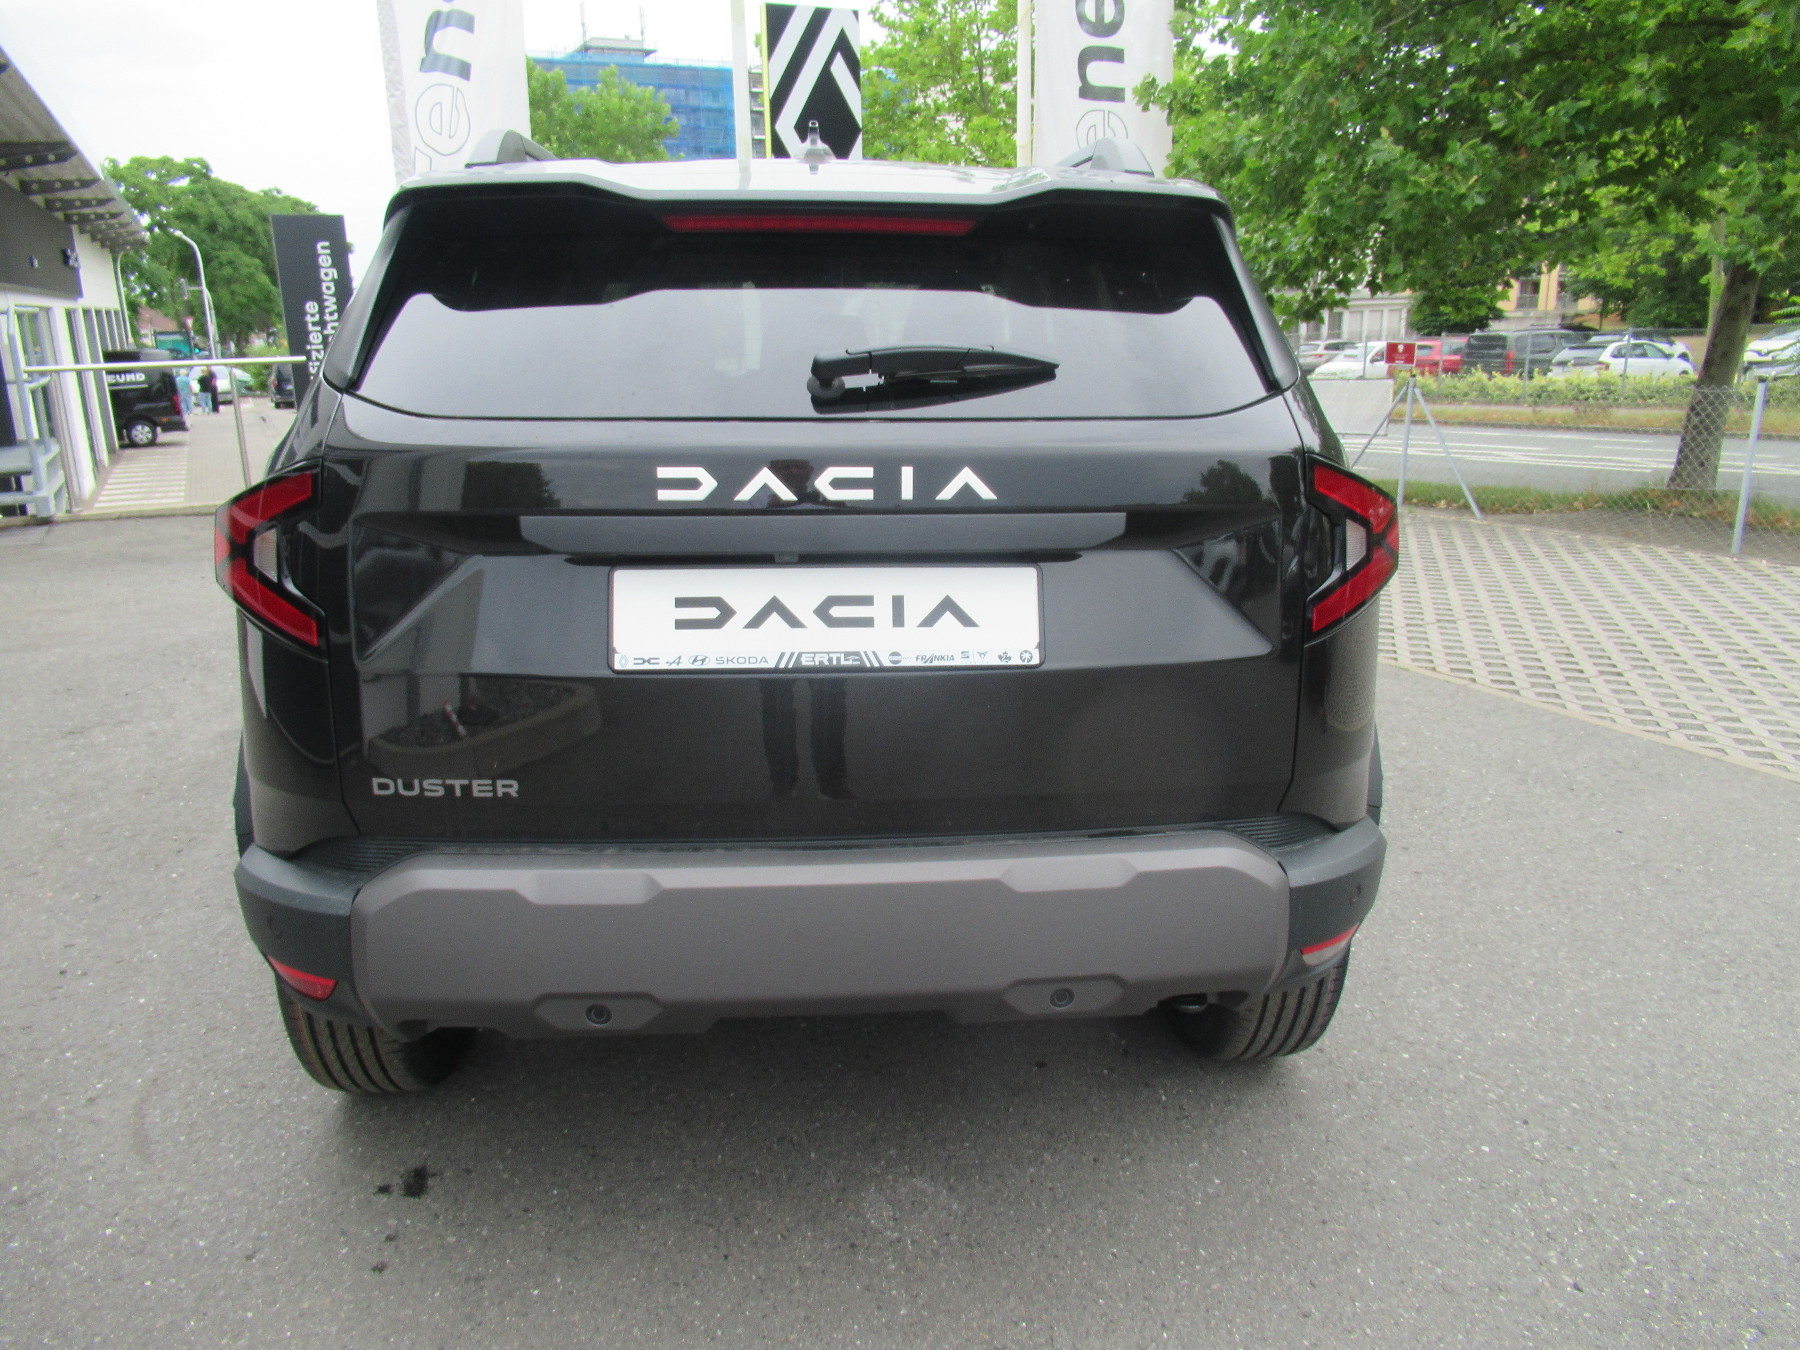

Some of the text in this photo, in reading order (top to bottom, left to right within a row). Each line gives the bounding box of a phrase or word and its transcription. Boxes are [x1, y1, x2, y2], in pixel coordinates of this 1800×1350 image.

[316, 240, 339, 342] htwagen
[304, 300, 325, 380] fizierte
[656, 465, 998, 501] DACIA
[674, 594, 980, 630] DACIA
[915, 653, 955, 664] FRANKIA
[371, 777, 519, 798] DUSTER
